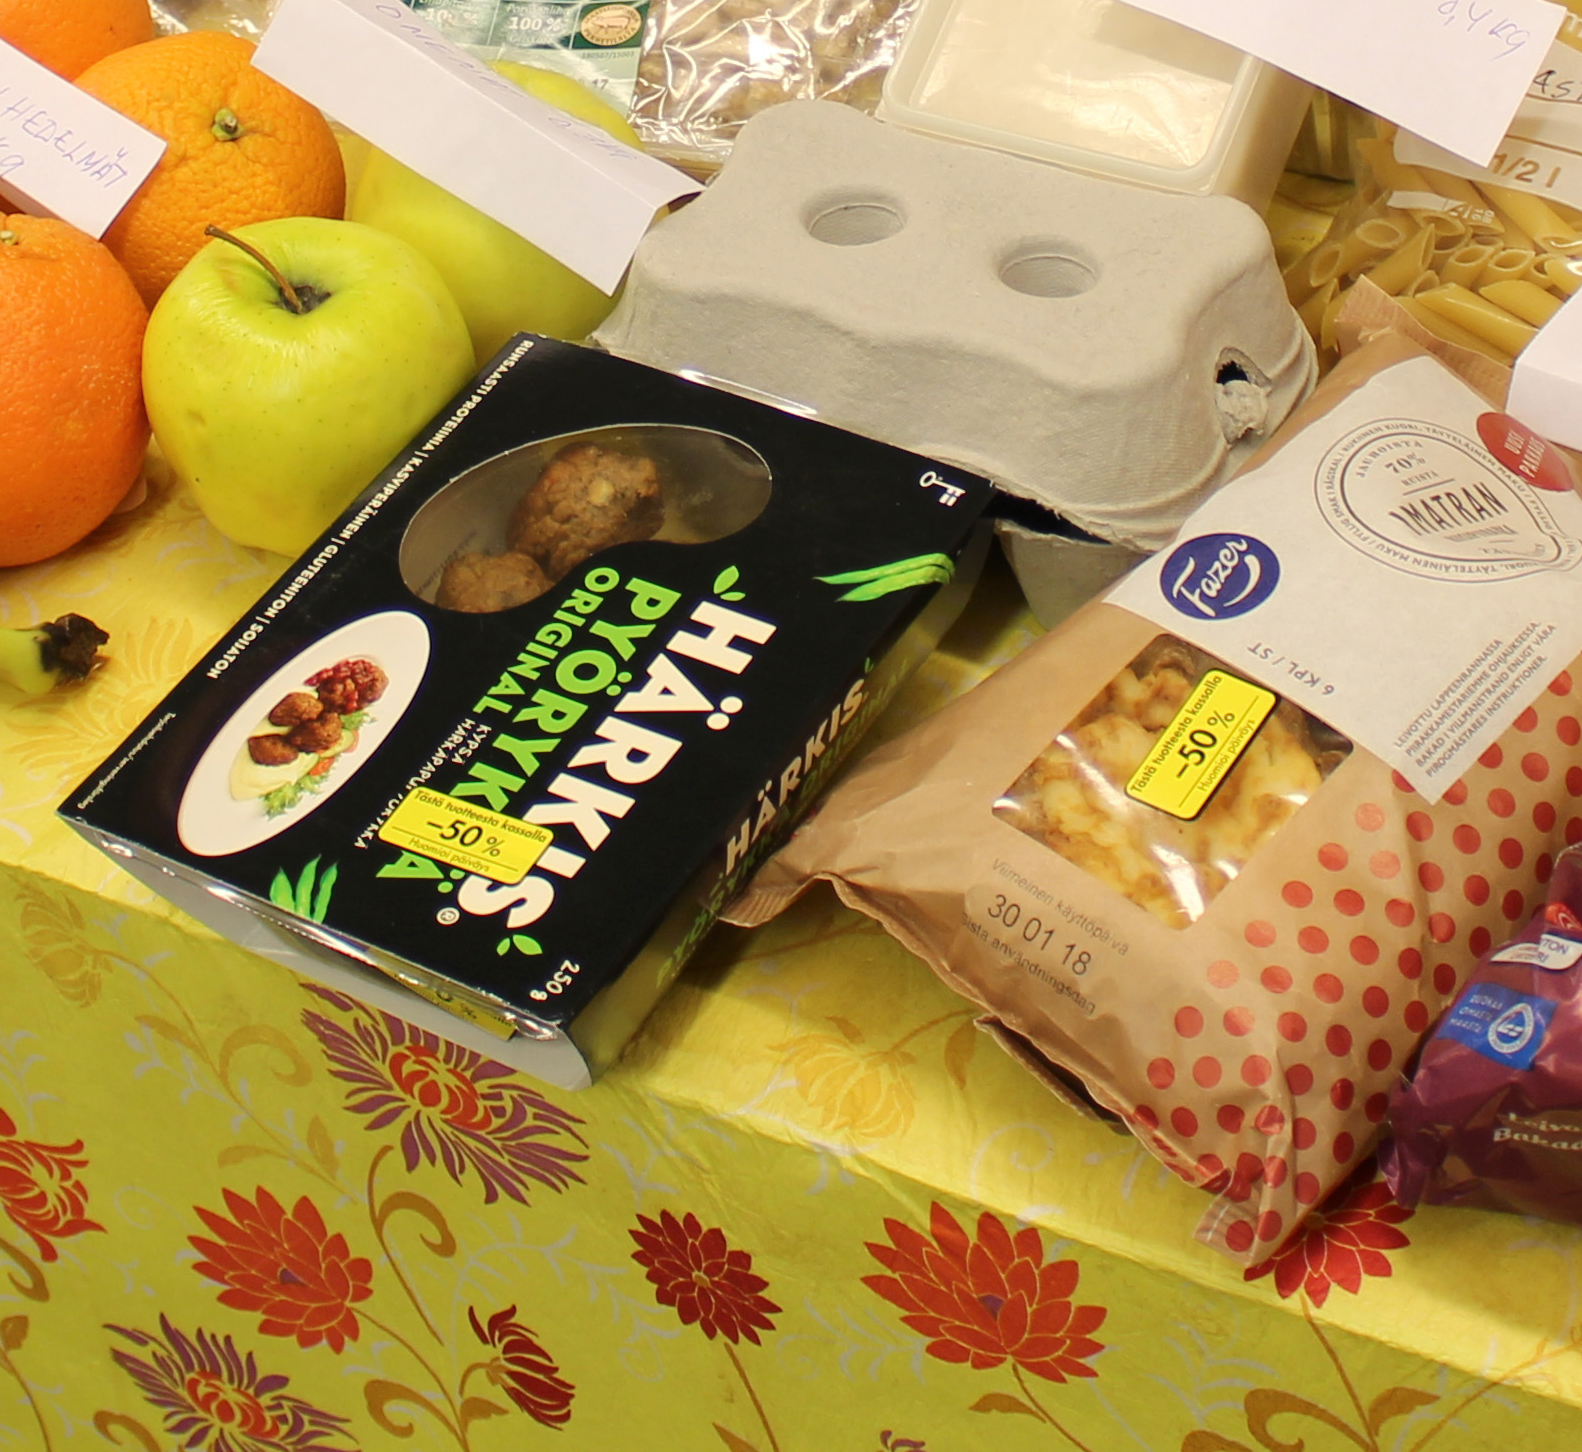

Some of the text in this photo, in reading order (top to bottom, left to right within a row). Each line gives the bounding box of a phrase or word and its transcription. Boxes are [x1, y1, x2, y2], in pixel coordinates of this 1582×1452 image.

[507, 13, 545, 31] 100
[421, 339, 535, 452] RUNSAASTI PROTEIINIA
[1356, 438, 1424, 479] JAUHOISTA
[1383, 451, 1427, 478] 70%
[1400, 469, 1440, 488] RUISTA
[263, 457, 423, 621] KASVIPERÄINEN GLUTEENITON
[1387, 480, 1510, 538] IMATRAN
[1172, 533, 1250, 617] Fazer
[472, 567, 620, 716] ORIGINAL
[1246, 641, 1322, 688] KPL ST
[1393, 638, 1504, 749] LEIVOTTU LAPPEENRANNASSA
[1447, 623, 1557, 736] VILLMANSTRAND ENLIGT VÅRA
[375, 577, 683, 894] PYÖRYKÄ
[457, 600, 778, 929] HÄRKIS
[1129, 674, 1223, 795] Tästä tuotteesta kassalla
[1196, 718, 1257, 793] Huomioi päiväys
[1424, 714, 1489, 779] PIROGMÄSTARES
[414, 788, 549, 845] Tästä tuotteesta kassalla
[407, 836, 491, 875] Huomioi päiväys
[985, 892, 1094, 978] 30 01 18
[546, 958, 581, 996] 250
[1468, 993, 1504, 1011] RUOKAA
[1448, 1016, 1483, 1035] MAASTA
[1458, 1005, 1494, 1022] OMASTA
